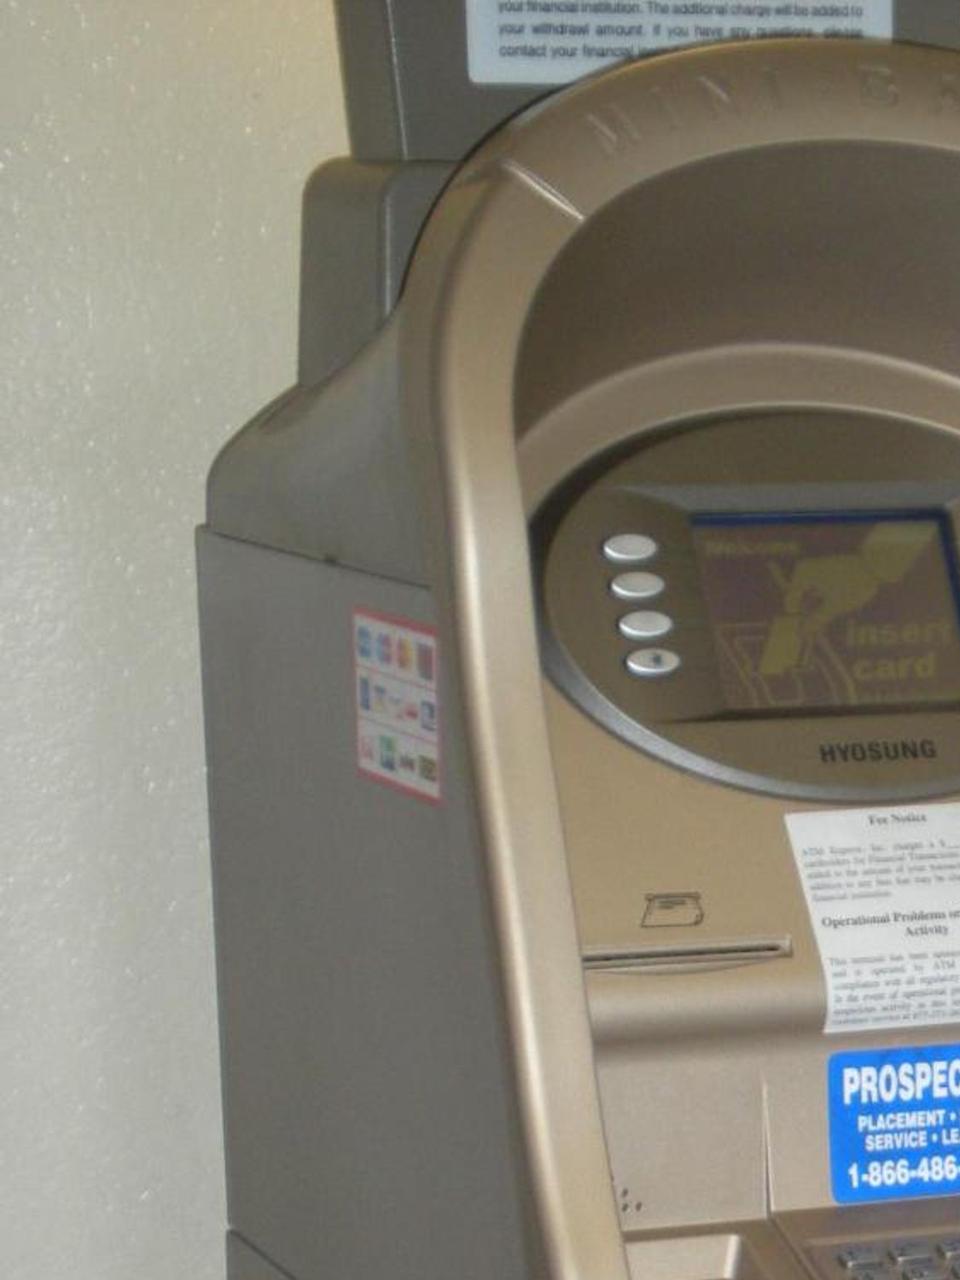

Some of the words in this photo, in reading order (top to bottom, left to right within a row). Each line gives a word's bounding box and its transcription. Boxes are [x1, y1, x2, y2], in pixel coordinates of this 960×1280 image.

[499, 24, 525, 37] your
[668, 26, 689, 40] you
[500, 44, 547, 58] contact
[551, 45, 577, 60] your
[819, 738, 937, 764] HYOSUNG
[821, 912, 891, 930] Operational
[892, 907, 947, 923] Problems
[904, 923, 949, 938] Activity
[857, 1109, 946, 1133] PLACEMENT
[865, 1130, 928, 1152] SERVICE
